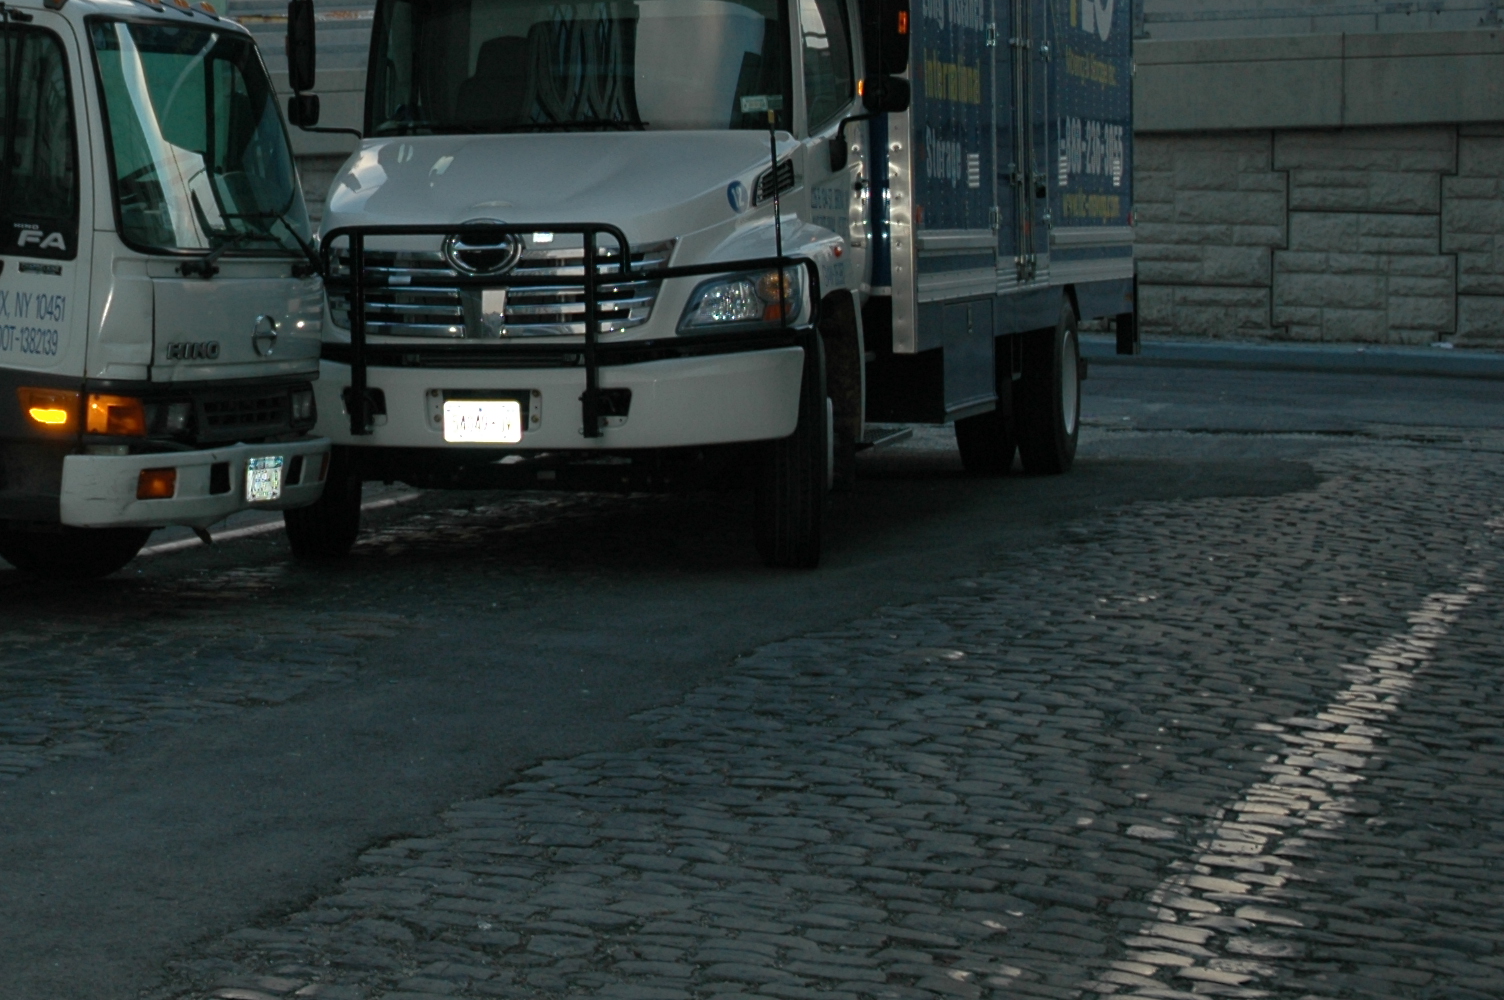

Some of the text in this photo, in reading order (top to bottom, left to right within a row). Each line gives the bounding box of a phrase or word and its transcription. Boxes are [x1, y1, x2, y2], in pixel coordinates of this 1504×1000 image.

[925, 124, 962, 189] Storage
[17, 229, 67, 251] FA
[14, 291, 33, 318] NY
[36, 294, 66, 323] 10451
[166, 341, 221, 360] HINO
